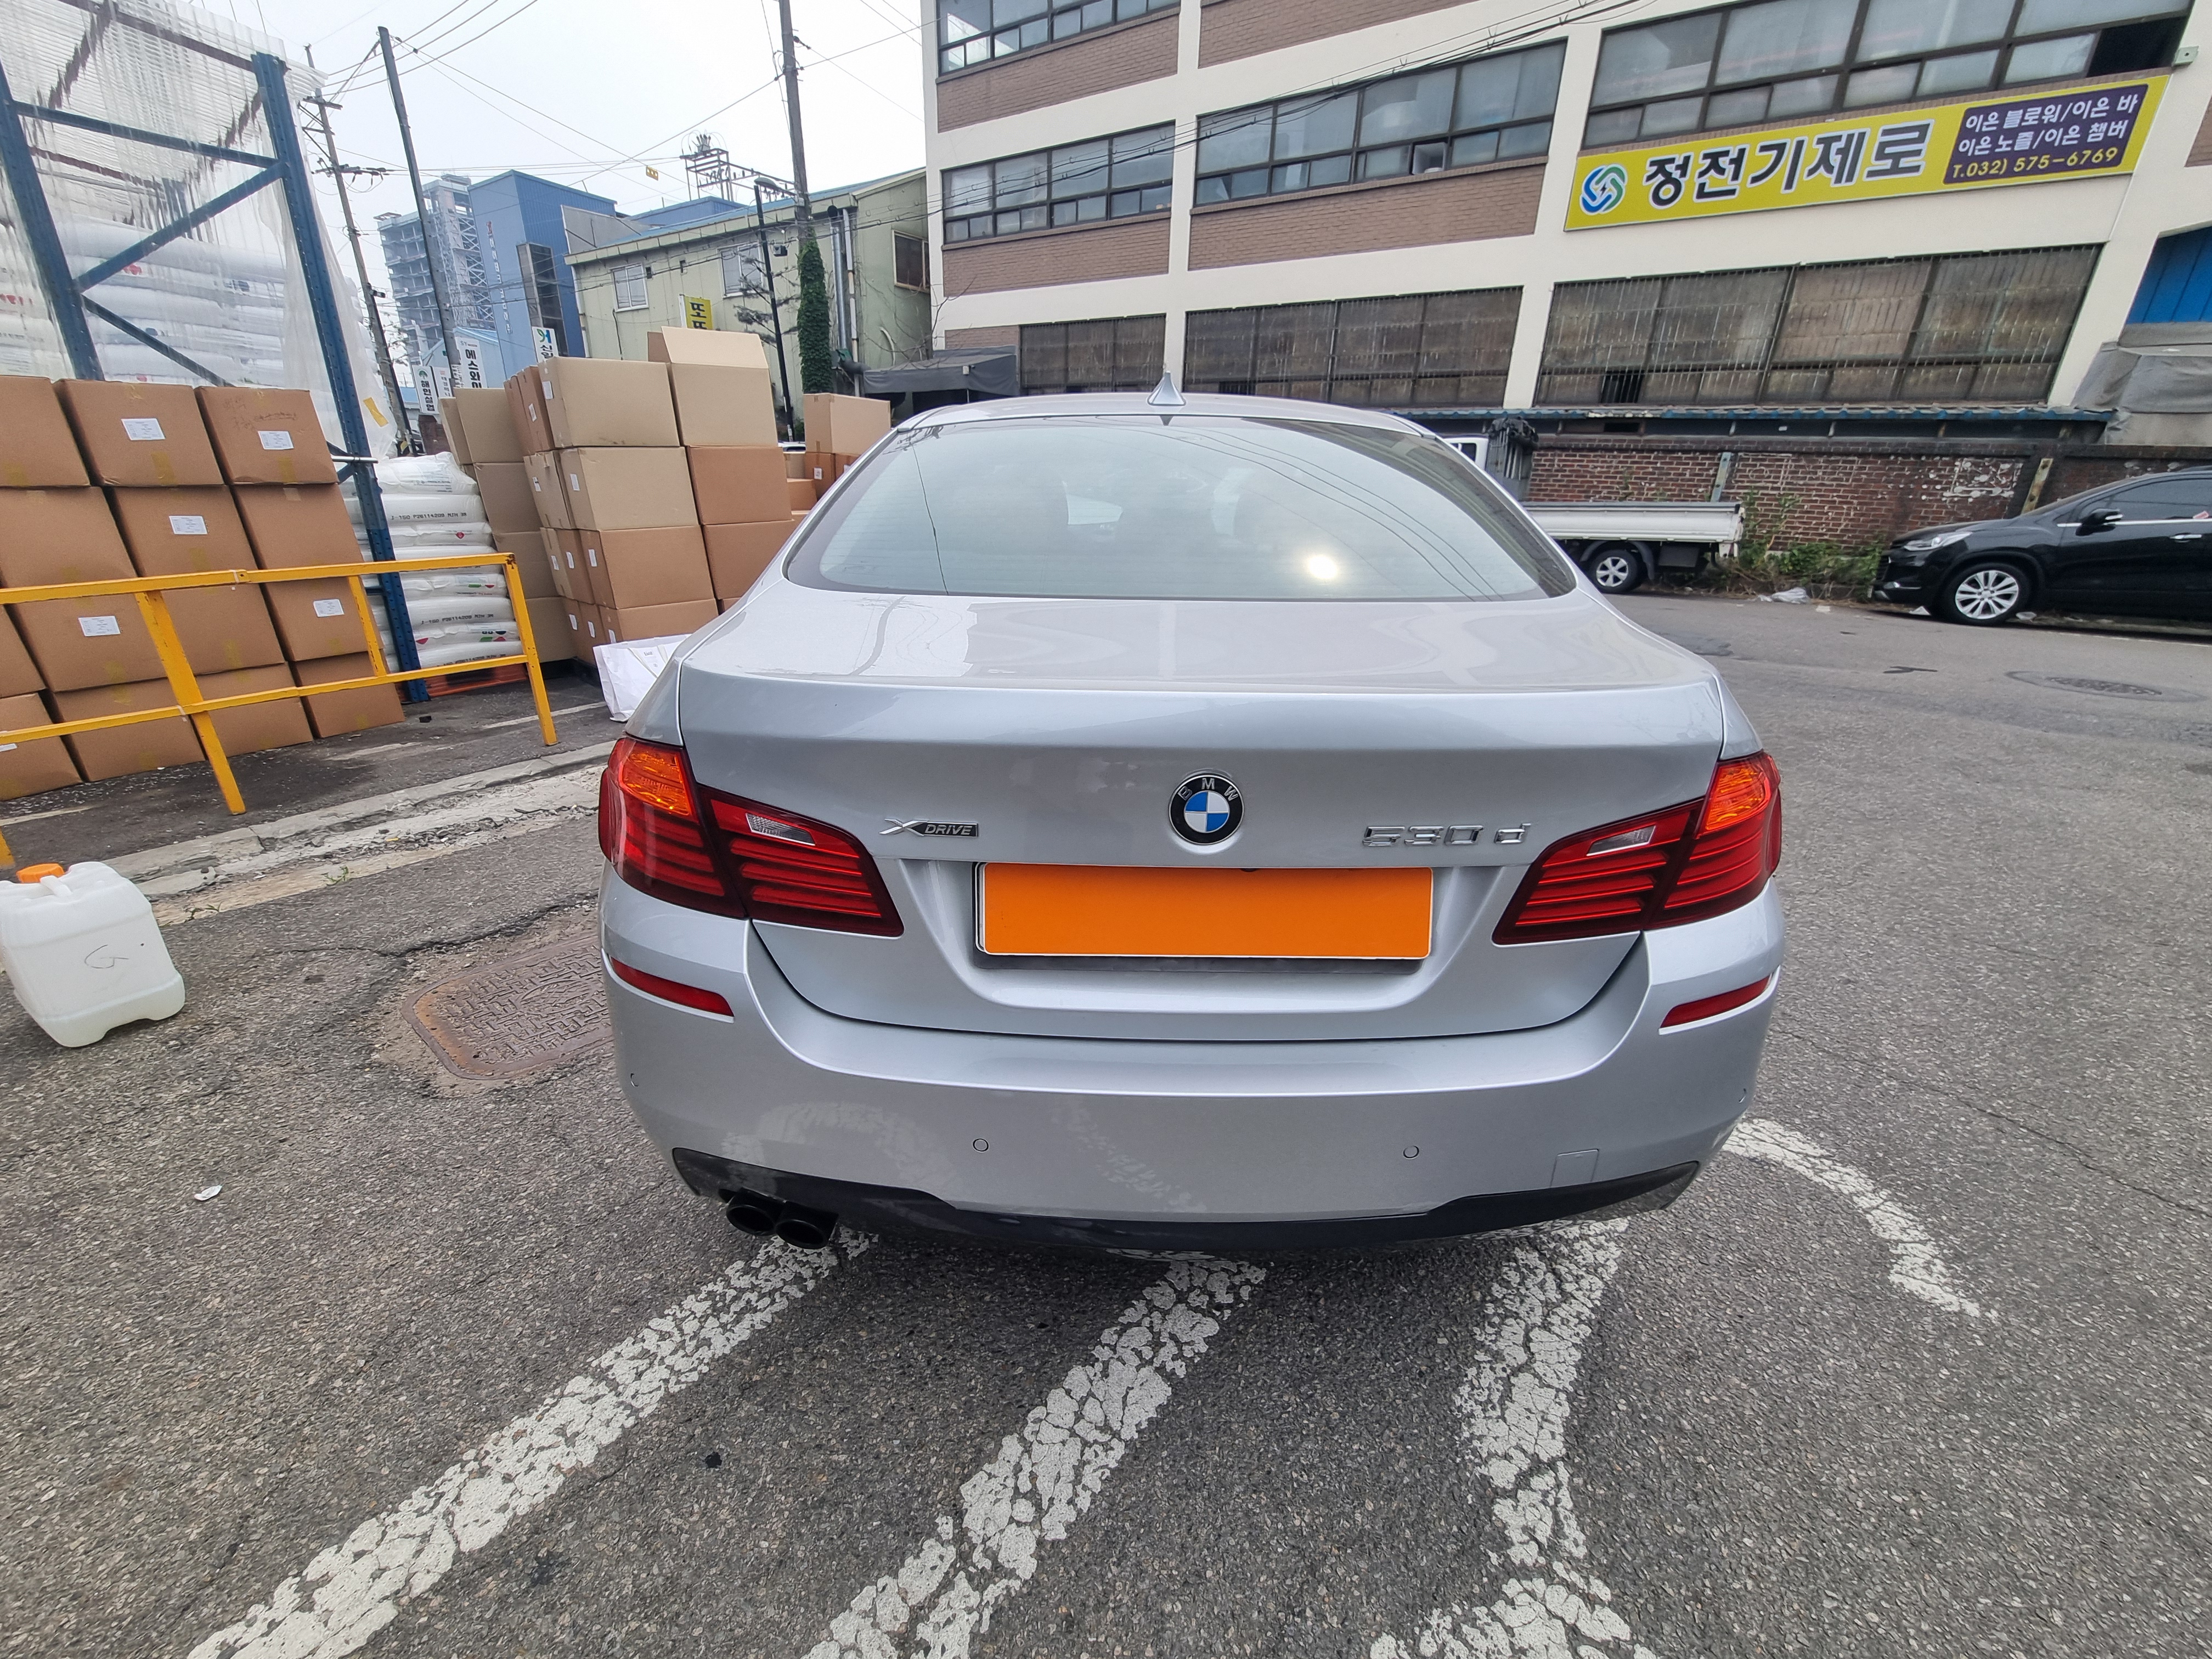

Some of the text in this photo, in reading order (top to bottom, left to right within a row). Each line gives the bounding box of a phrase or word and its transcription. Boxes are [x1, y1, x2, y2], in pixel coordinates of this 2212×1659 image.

[1966, 111, 1999, 133] 이온
[2117, 94, 2138, 114] 바
[1959, 135, 1992, 156] 이온
[2086, 119, 2129, 143] 챔버
[1645, 121, 1933, 208] 정전기제로
[1953, 147, 2118, 179] T.032) 575-6769
[1177, 778, 1239, 801] BMW
